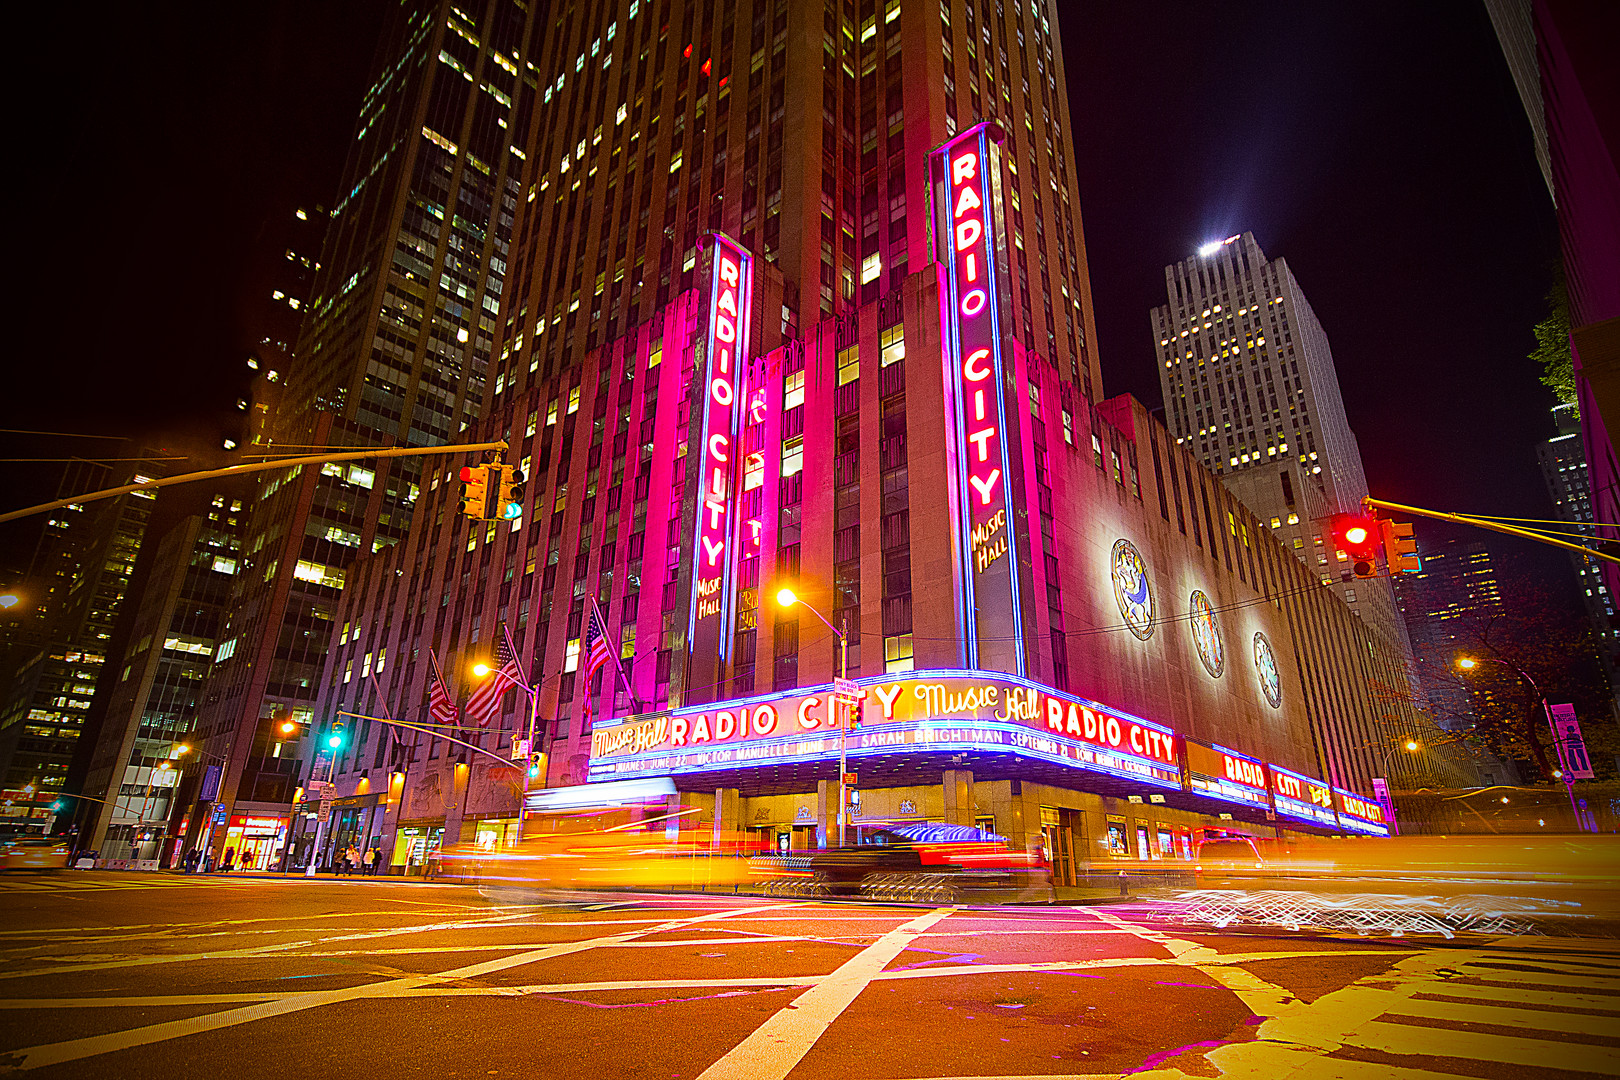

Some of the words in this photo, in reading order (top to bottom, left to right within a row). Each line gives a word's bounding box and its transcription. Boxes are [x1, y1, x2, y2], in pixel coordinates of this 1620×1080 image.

[953, 153, 986, 315] RADIO
[711, 257, 738, 406] RADIO
[964, 349, 1000, 505] CITY
[702, 433, 728, 566] CITY
[971, 509, 1005, 551] MUSIC
[978, 536, 1007, 573] HALL
[697, 577, 721, 598] MUSIC
[697, 598, 721, 620] HALL
[594, 730, 634, 757] Music
[629, 717, 669, 755] Hall
[670, 704, 779, 747] RADIO
[914, 684, 998, 718] Music
[994, 686, 1040, 722] Hall
[1047, 697, 1121, 747] RADIO
[1130, 725, 1173, 762] CITY
[861, 731, 905, 748] SARAH
[914, 729, 1002, 744] BRIGHTMAN
[697, 750, 731, 764] VICTOR
[736, 744, 789, 760] MANUELLE
[1224, 755, 1264, 787] RADIO
[1277, 773, 1301, 798] CITY
